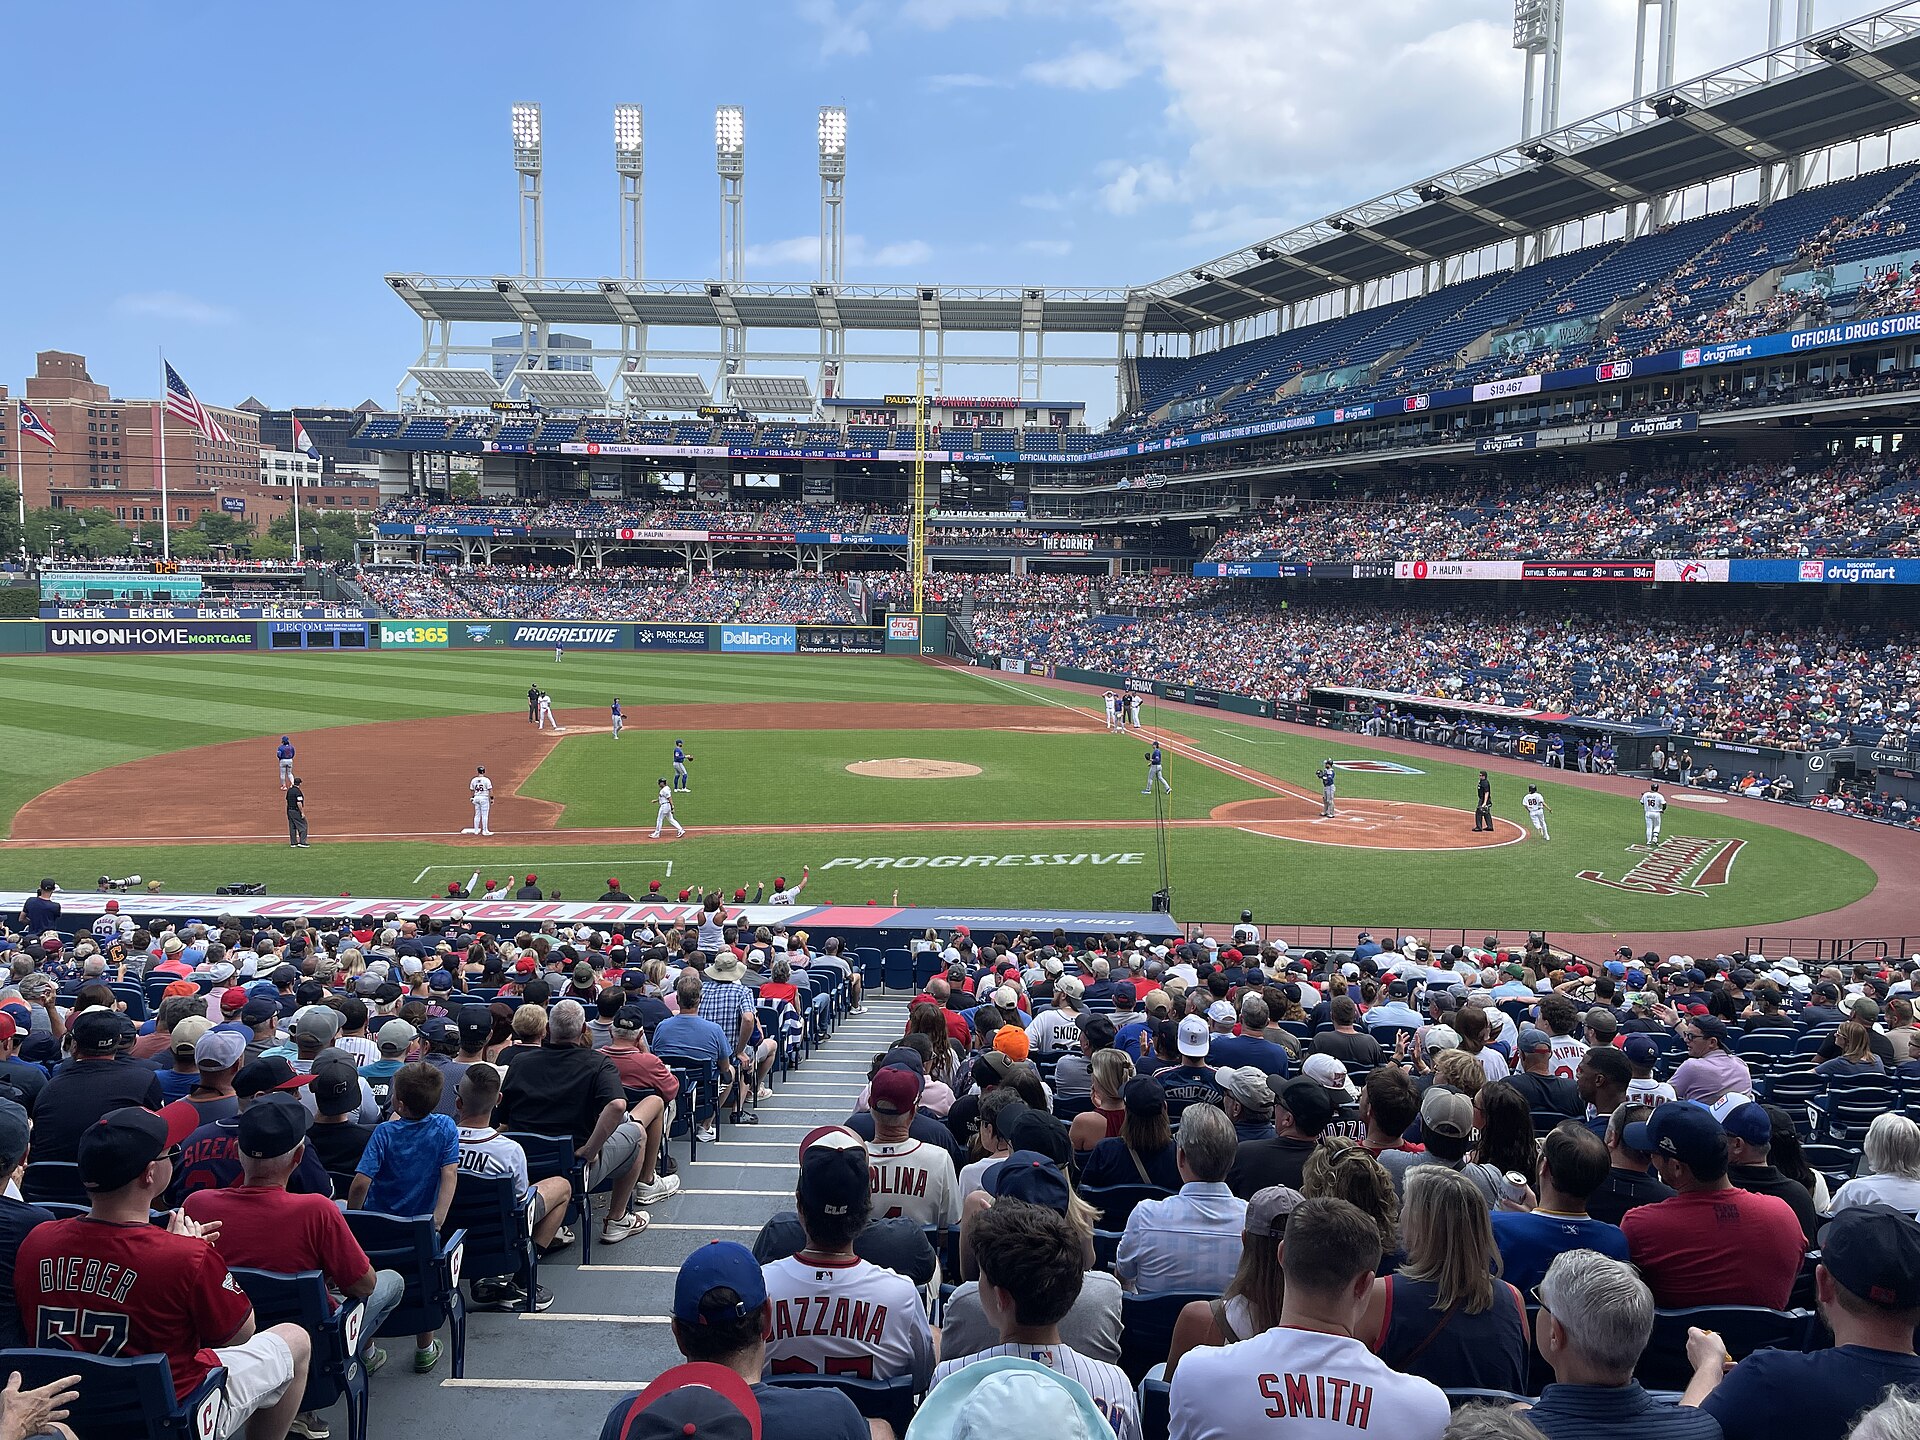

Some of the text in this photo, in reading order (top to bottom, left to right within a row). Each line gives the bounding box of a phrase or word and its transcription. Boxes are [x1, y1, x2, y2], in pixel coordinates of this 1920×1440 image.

[1791, 316, 1920, 348] OFFICIAL DRUG STORE
[1702, 345, 1752, 362] drug mart
[1490, 382, 1522, 396] $19,467
[1344, 408, 1372, 420] drug mart
[1630, 418, 1683, 436] drug mart
[1483, 440, 1502, 452] drug
[1019, 454, 1047, 462] OFFICIAL
[1048, 453, 1066, 462] DRUG
[1043, 538, 1094, 550] THE CORNER
[1228, 568, 1239, 576] drug
[1439, 566, 1462, 575] HALPIN
[1828, 566, 1895, 582] drug mart
[892, 619, 914, 630] drug
[188, 634, 252, 644] MORTGAGE
[381, 626, 448, 643] bet365
[514, 626, 618, 643] PROGRESSIVE
[656, 630, 704, 639] PARK PLACE
[893, 629, 918, 637] mart
[820, 852, 1146, 870] PROGRESSIVE
[934, 915, 1072, 924] PROGRESSIVE
[110, 945, 125, 962] C
[1554, 1047, 1585, 1060] KIPNIS
[184, 1136, 239, 1168] SIZEM
[870, 1166, 928, 1198] OLINA
[824, 1204, 848, 1215] CLE
[39, 1256, 138, 1304] BIEBER
[1258, 1372, 1374, 1430] SMITH
